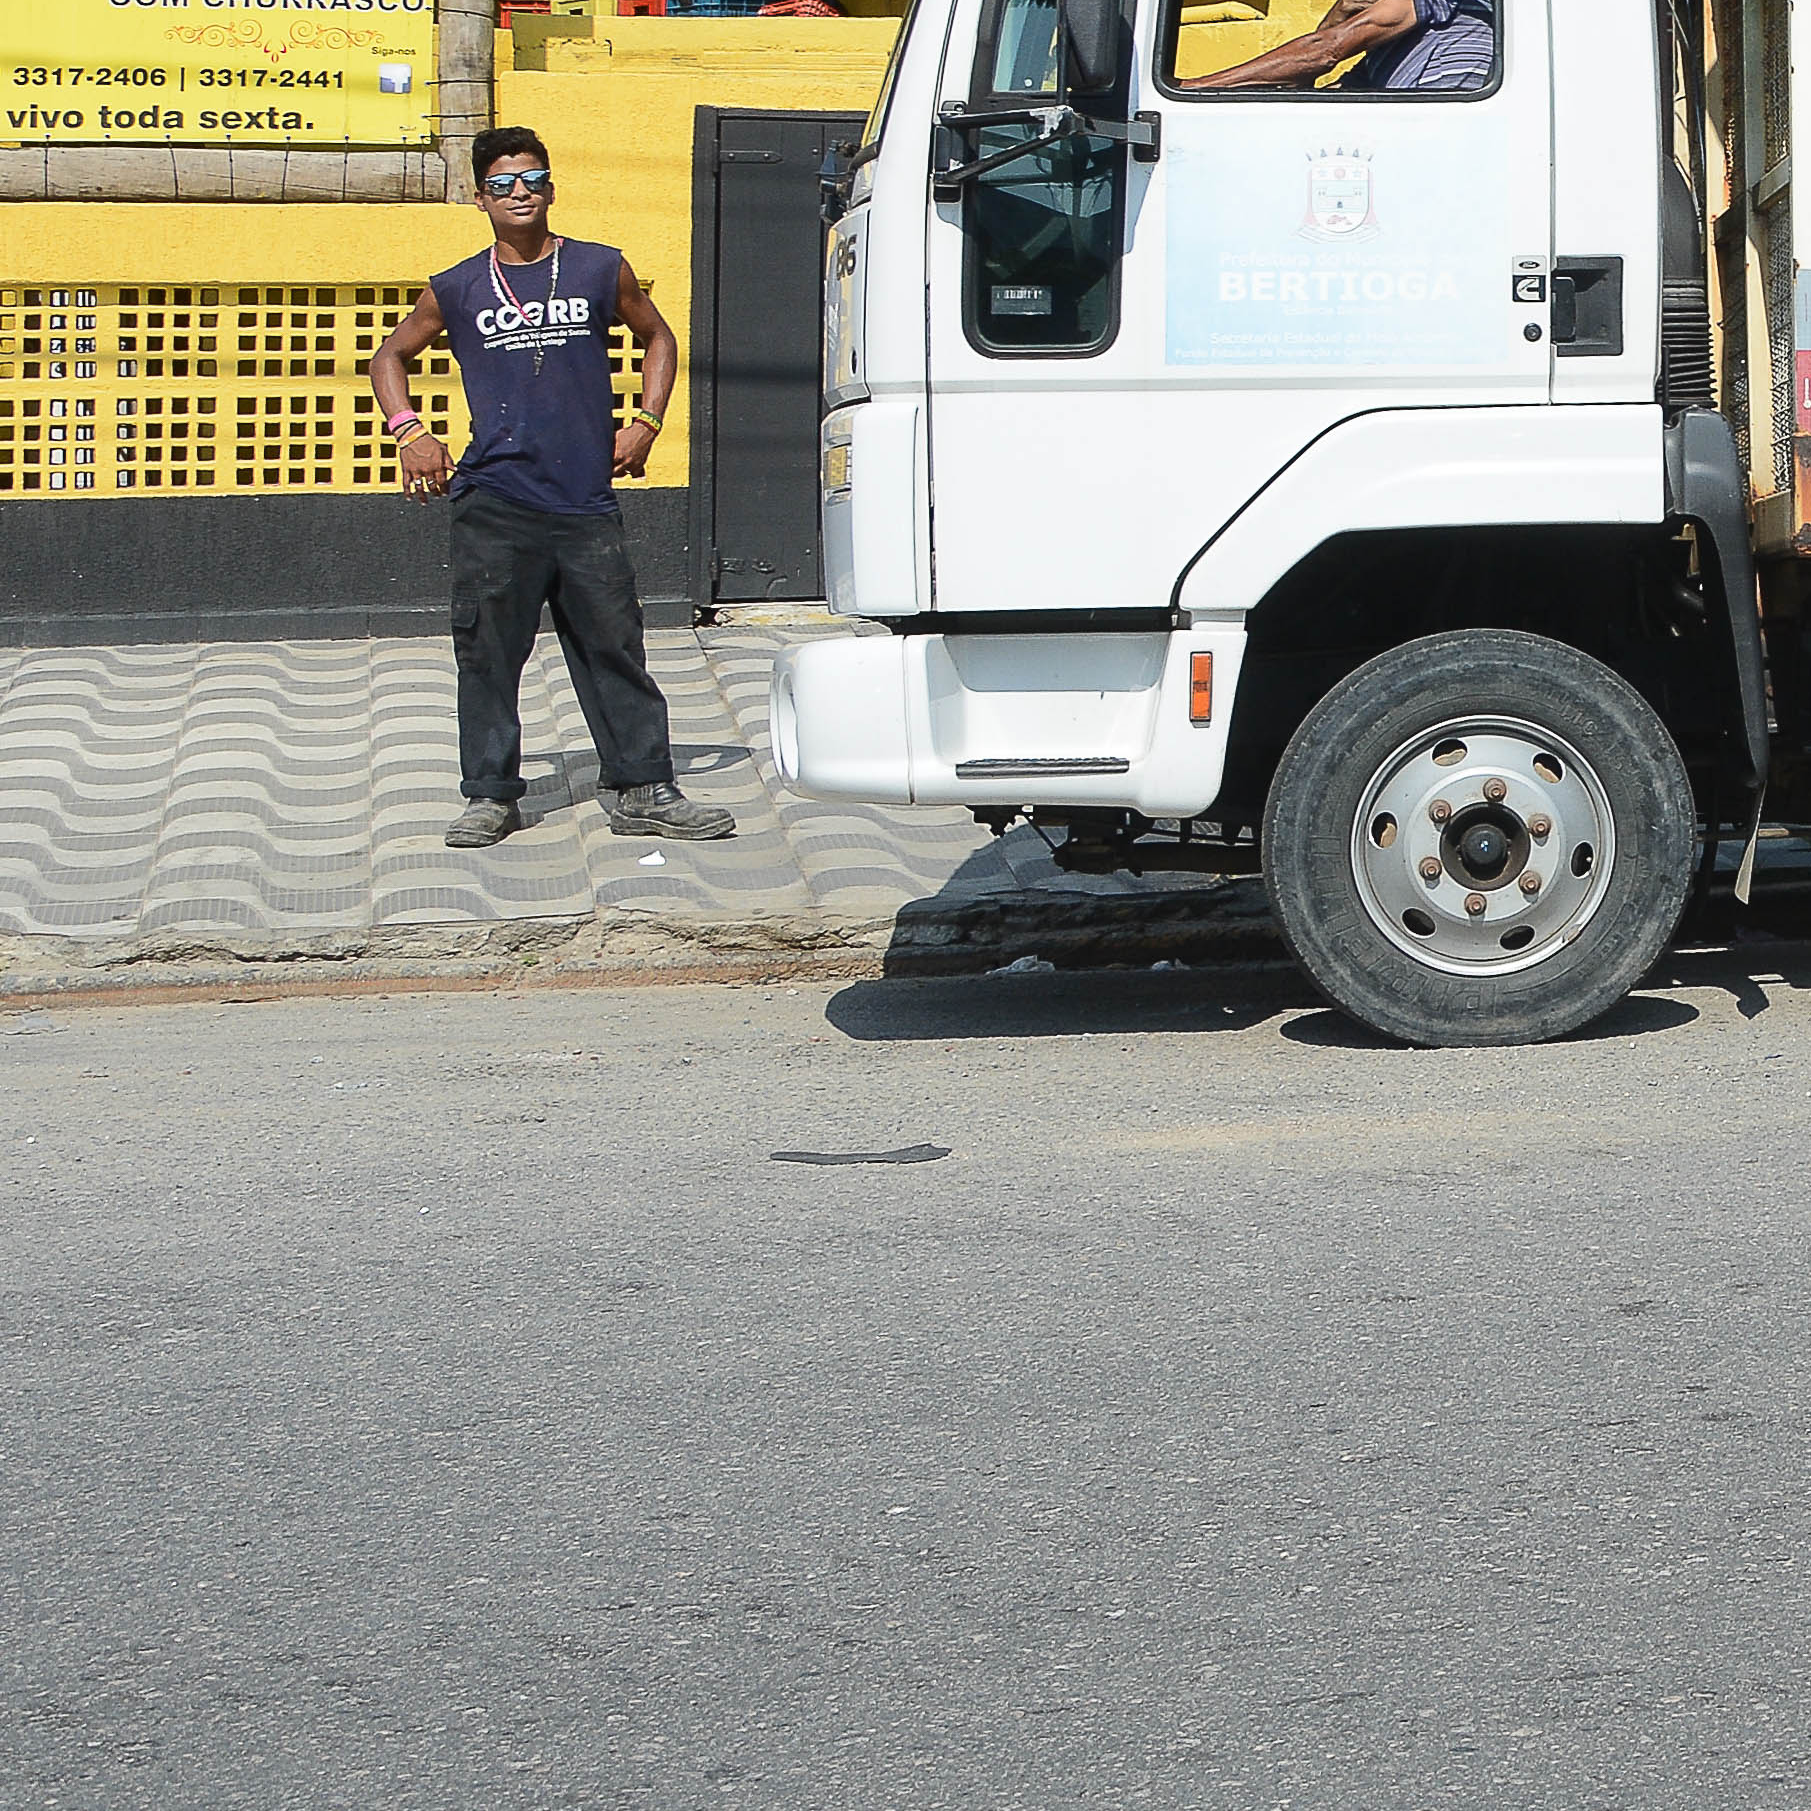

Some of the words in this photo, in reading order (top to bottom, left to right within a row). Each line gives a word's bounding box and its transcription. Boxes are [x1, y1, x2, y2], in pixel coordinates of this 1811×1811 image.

[12, 67, 167, 87] 3317-2406
[199, 68, 345, 89] 3317-2441
[6, 103, 84, 129] vivo
[98, 105, 184, 129] toda
[198, 107, 315, 130] sexta.
[1218, 271, 1462, 301] BERTIOGA
